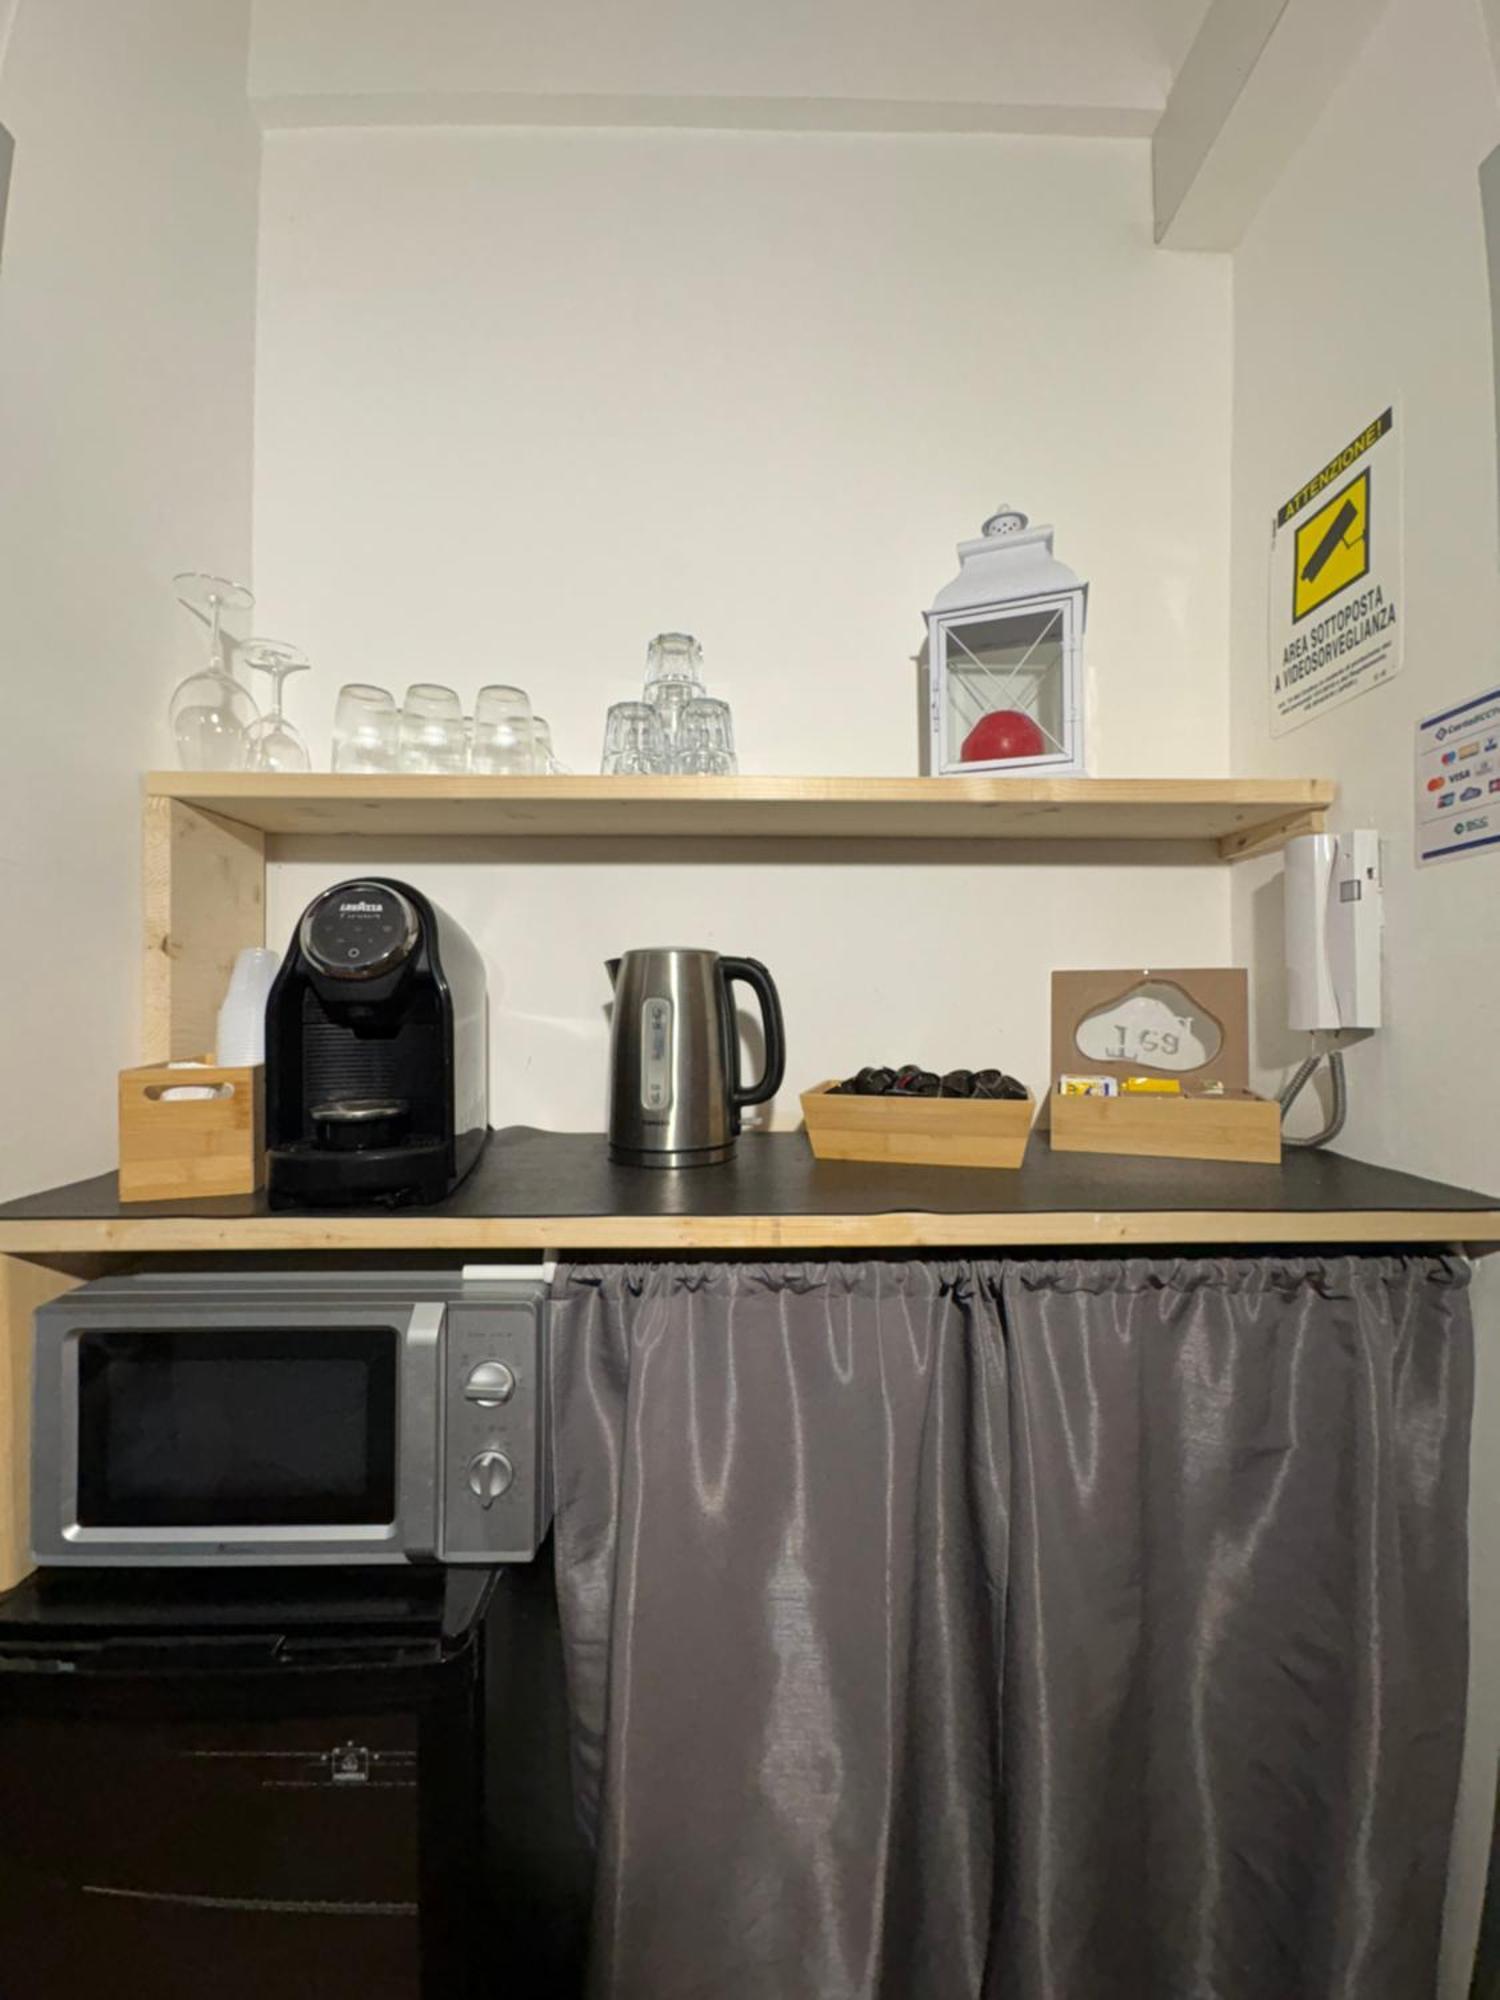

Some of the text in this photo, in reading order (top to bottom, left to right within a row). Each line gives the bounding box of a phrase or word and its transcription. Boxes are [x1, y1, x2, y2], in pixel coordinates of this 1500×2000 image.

[1284, 420, 1382, 521] ATTENZIONE!
[1275, 674, 1281, 694] A
[1283, 602, 1396, 688] VIDEOSORVEGLIANZA
[1283, 585, 1383, 667] AREA SOTTOPOSTA
[1448, 769, 1470, 783] VISA
